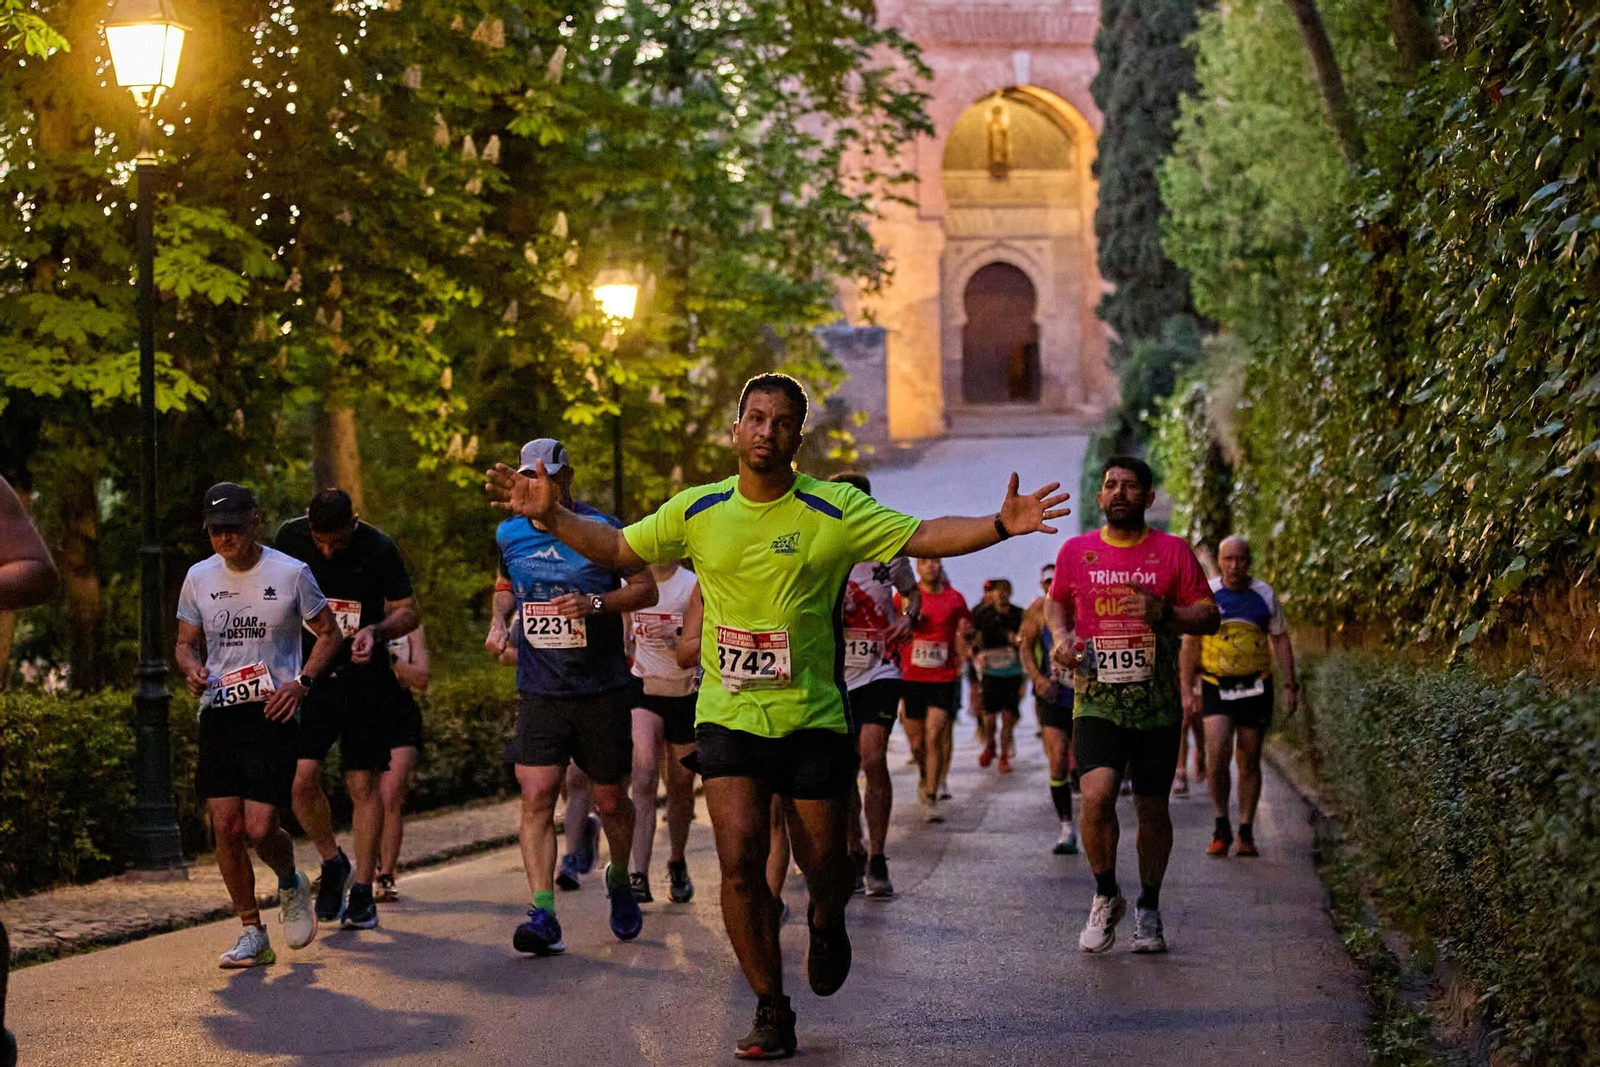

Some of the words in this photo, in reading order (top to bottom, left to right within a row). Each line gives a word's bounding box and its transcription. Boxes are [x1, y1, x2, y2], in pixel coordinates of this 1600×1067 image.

[227, 628, 266, 639] DESTINO
[527, 617, 572, 635] 2231
[848, 641, 880, 657] 134
[1098, 650, 1146, 669] 2195
[213, 679, 260, 706] 4597
